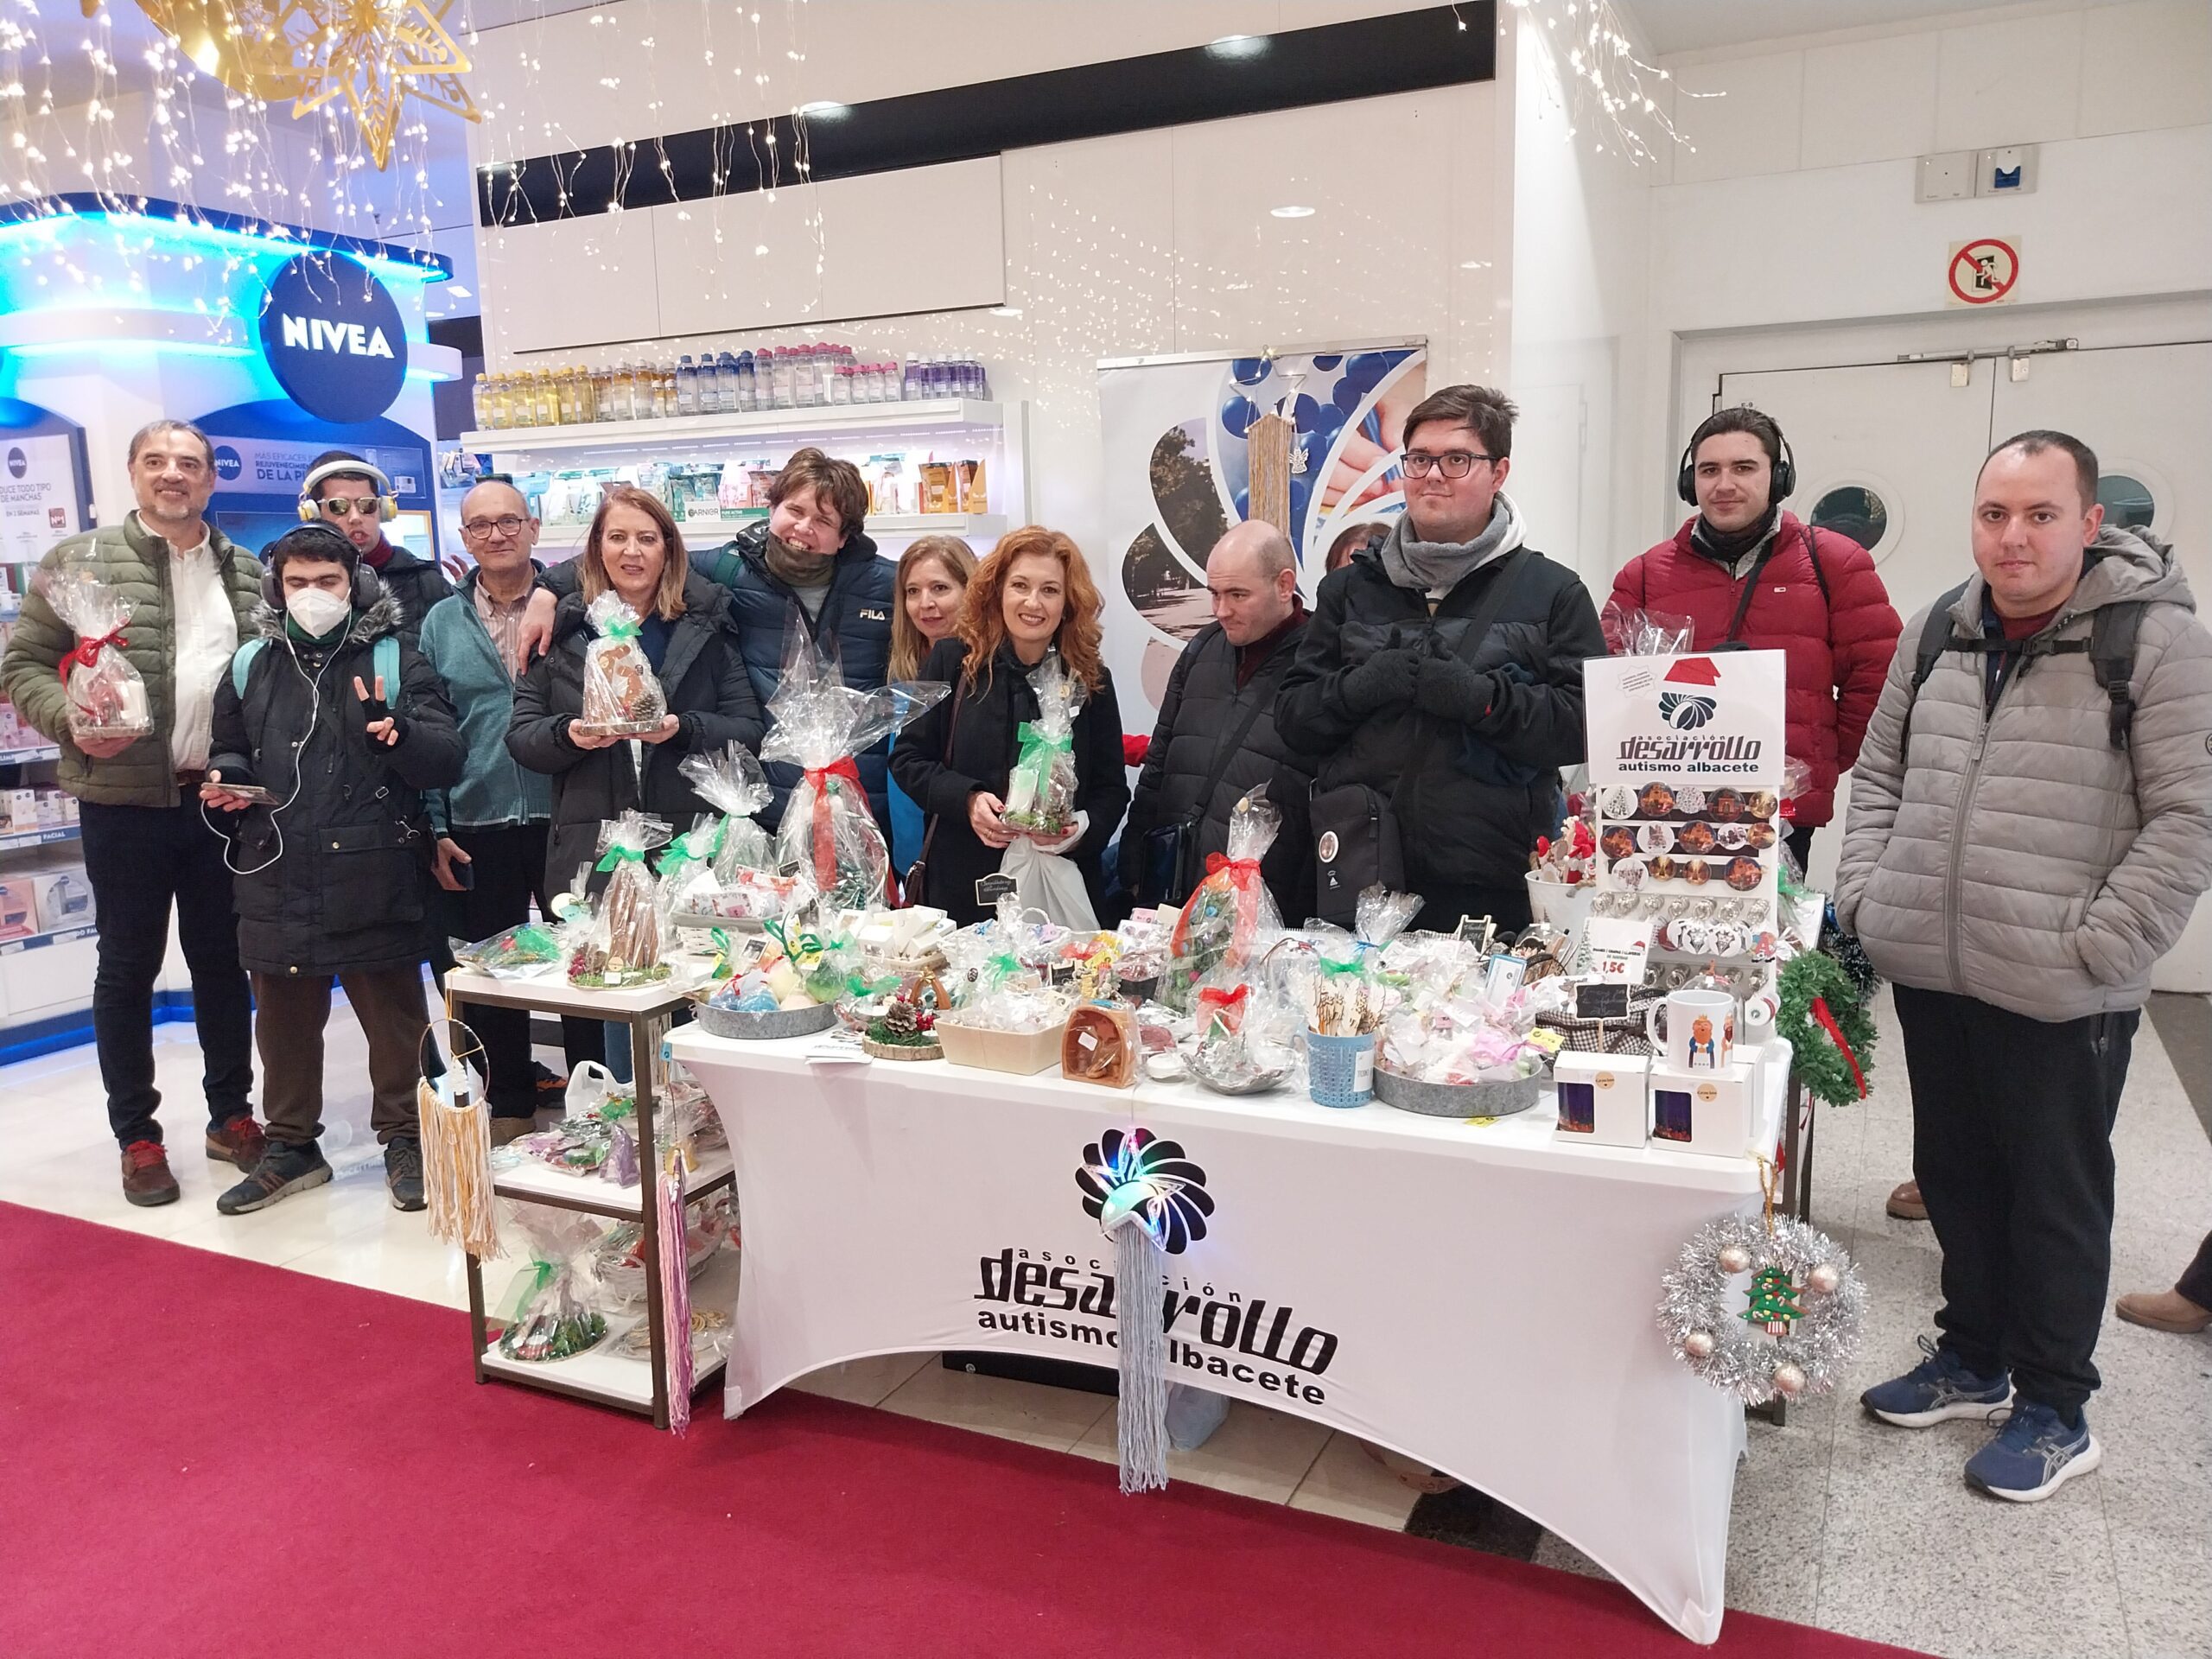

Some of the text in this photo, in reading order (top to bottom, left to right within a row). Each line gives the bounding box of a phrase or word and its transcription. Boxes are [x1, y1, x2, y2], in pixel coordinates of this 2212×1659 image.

[282, 312, 395, 359] NIVEA
[214, 459, 239, 467] NIVEA
[257, 468, 274, 480] DE
[277, 469, 292, 480] LA
[36, 482, 52, 492] TIPO
[11, 493, 41, 501] MANCHAS
[689, 508, 719, 517] GARNIER
[860, 608, 886, 620] FILA
[1616, 736, 1762, 760] desarrollo
[1618, 761, 1759, 773] autismo albacete
[43, 830, 66, 840] FACIAL
[973, 1247, 1338, 1376] desarollo
[1169, 1339, 1325, 1406] lbacete
